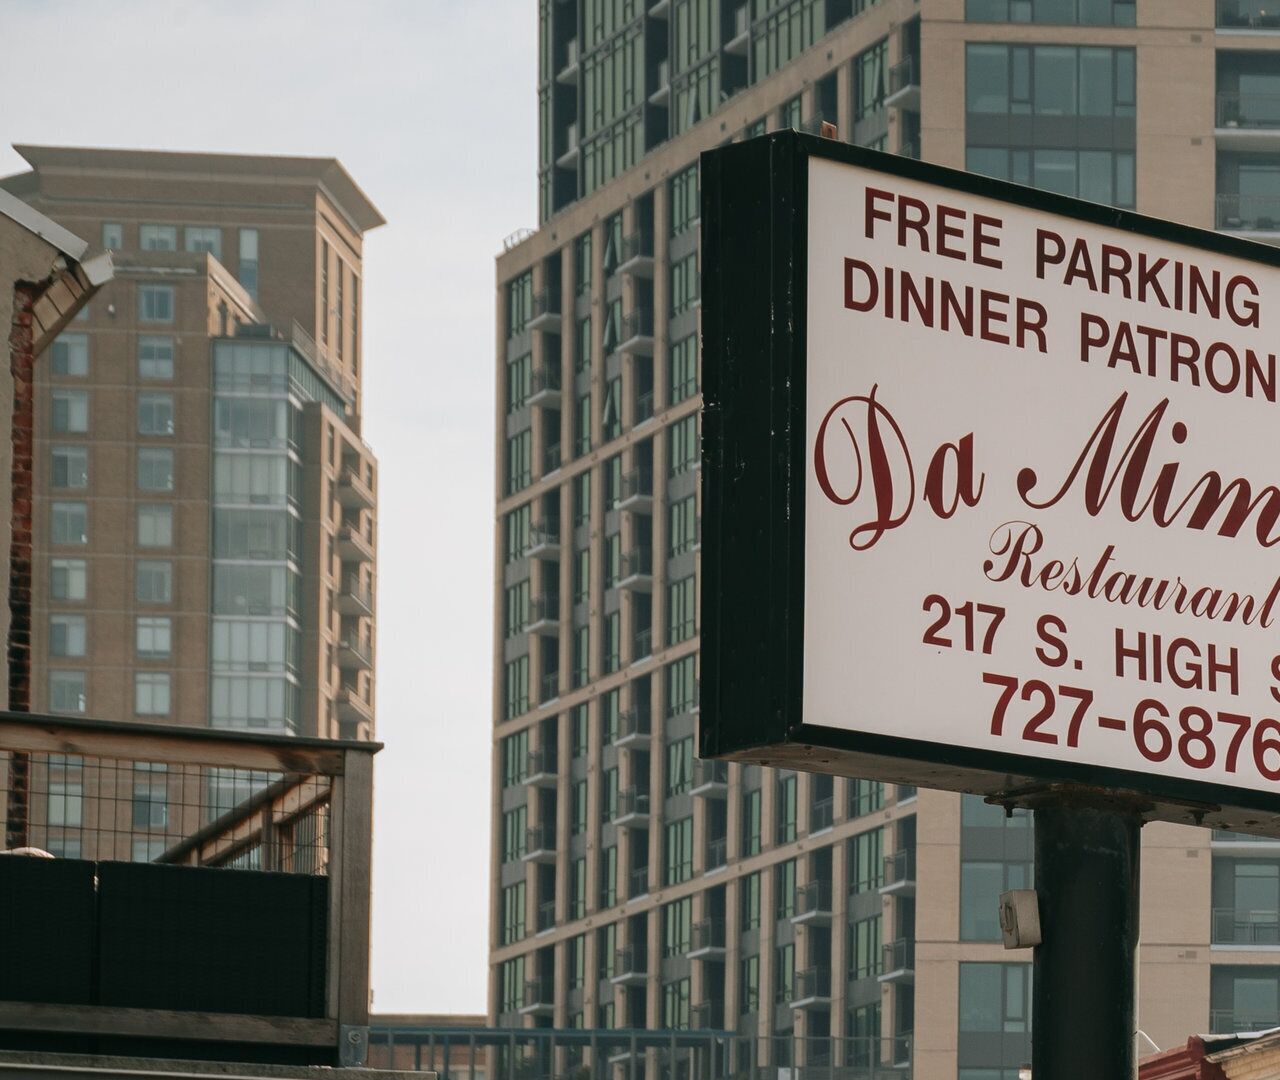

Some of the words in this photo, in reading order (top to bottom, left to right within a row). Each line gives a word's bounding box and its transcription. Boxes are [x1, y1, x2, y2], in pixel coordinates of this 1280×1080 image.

[844, 257, 1047, 352] DINNER
[865, 187, 1002, 268] FREE
[1037, 229, 1259, 327] PARKING
[814, 384, 984, 551] Da
[923, 595, 1005, 654] 217
[1036, 615, 1082, 670] S.
[1116, 628, 1238, 695] HIGH
